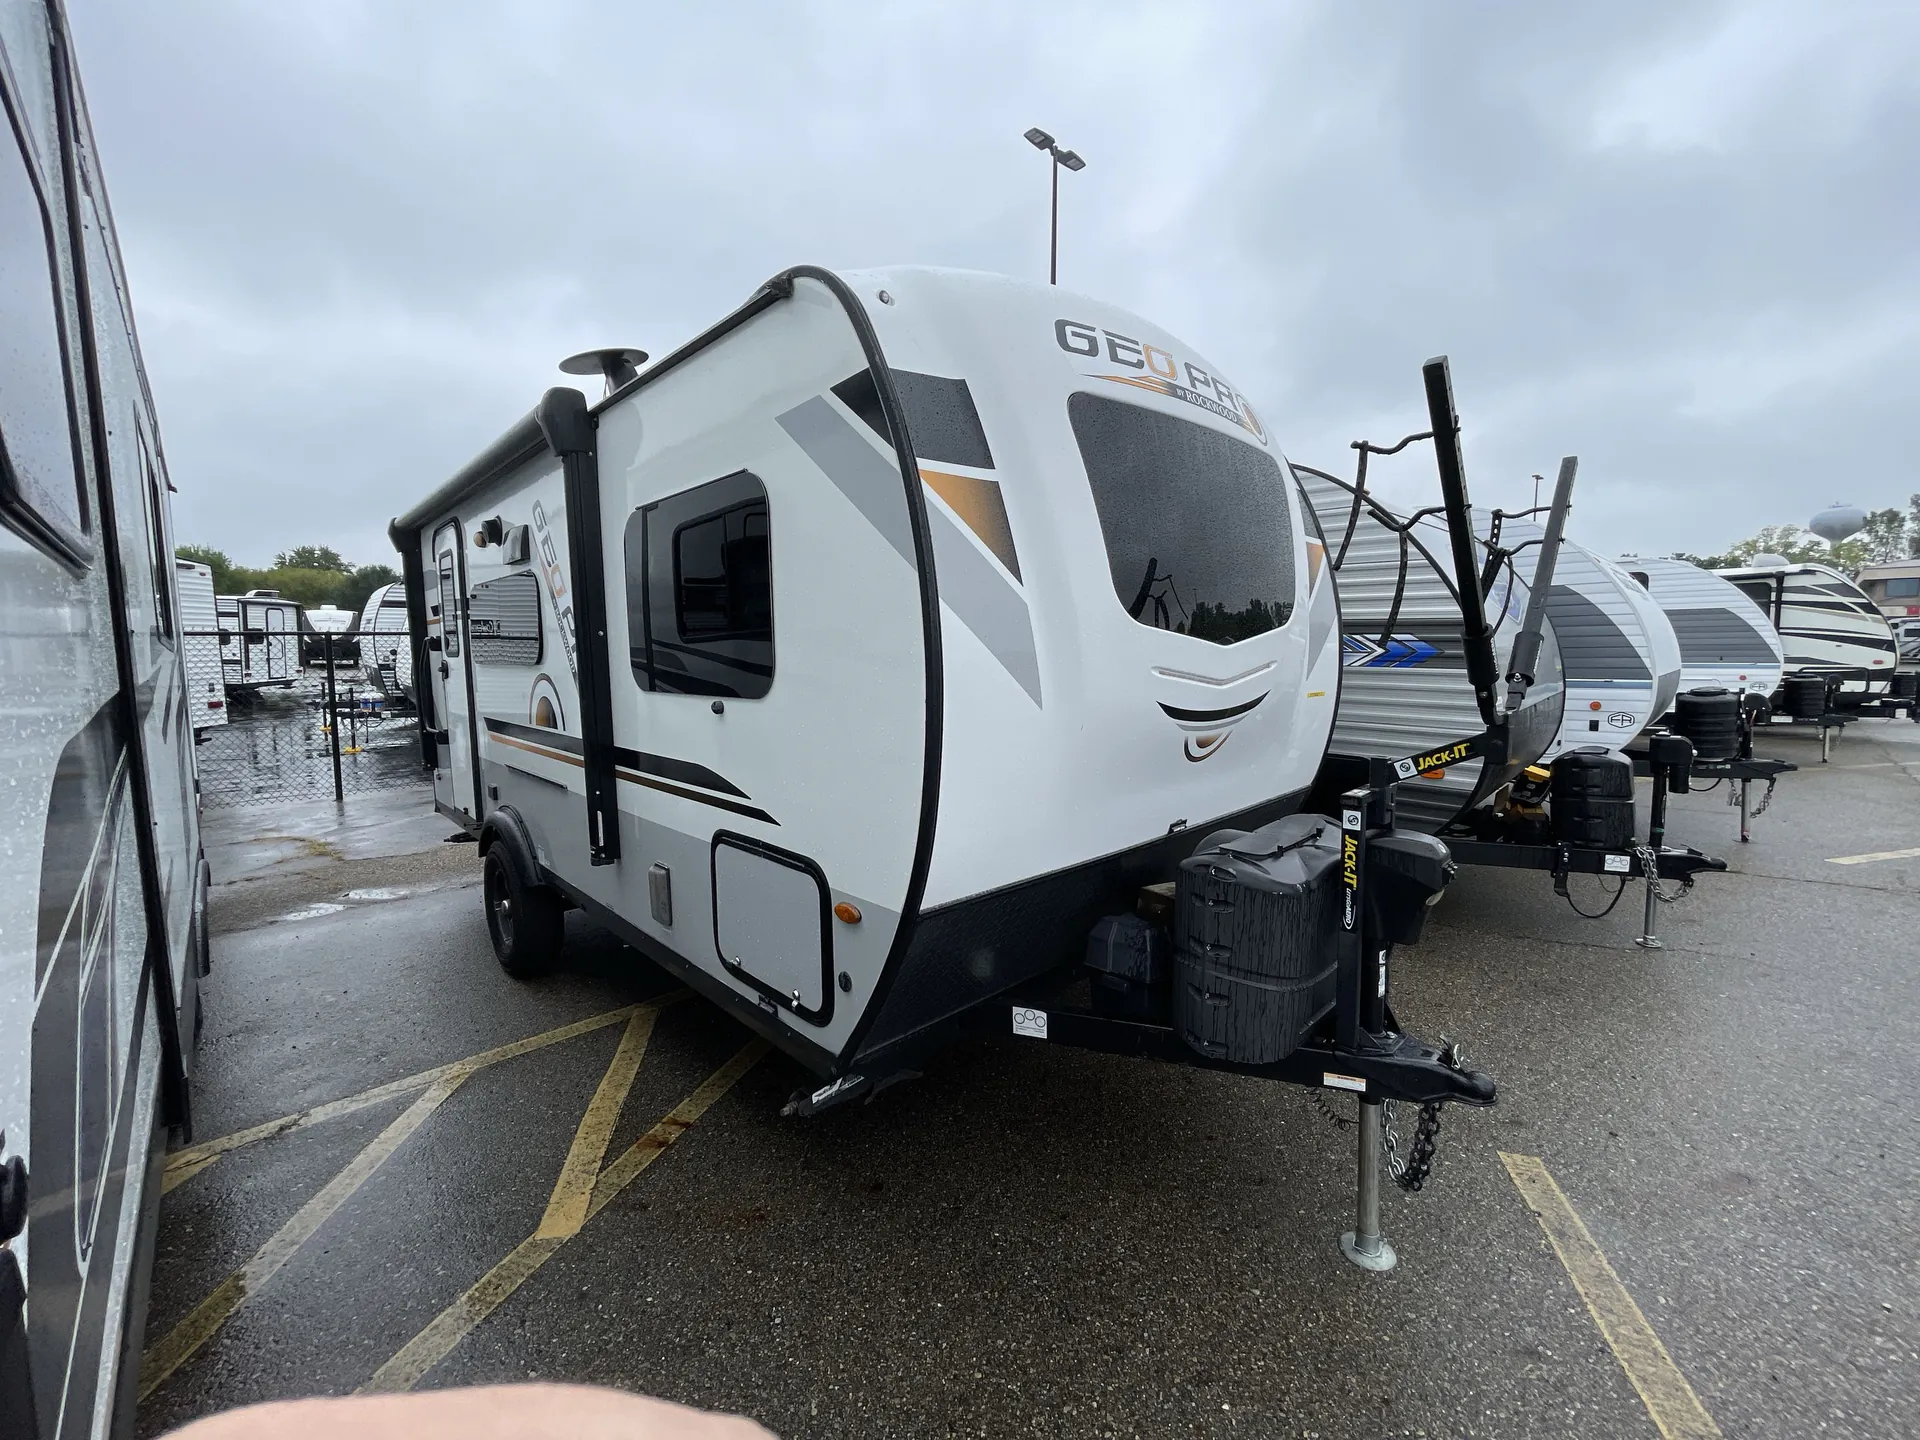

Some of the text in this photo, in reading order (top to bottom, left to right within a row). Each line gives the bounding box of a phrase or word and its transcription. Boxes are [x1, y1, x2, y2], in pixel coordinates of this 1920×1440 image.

[1054, 319, 1268, 446] GEO PRO
[1176, 388, 1237, 423] BY ROCKWOOD
[532, 499, 568, 598] GEO
[1418, 743, 1467, 770] JACK-IT
[1344, 834, 1358, 889] JACK-IT
